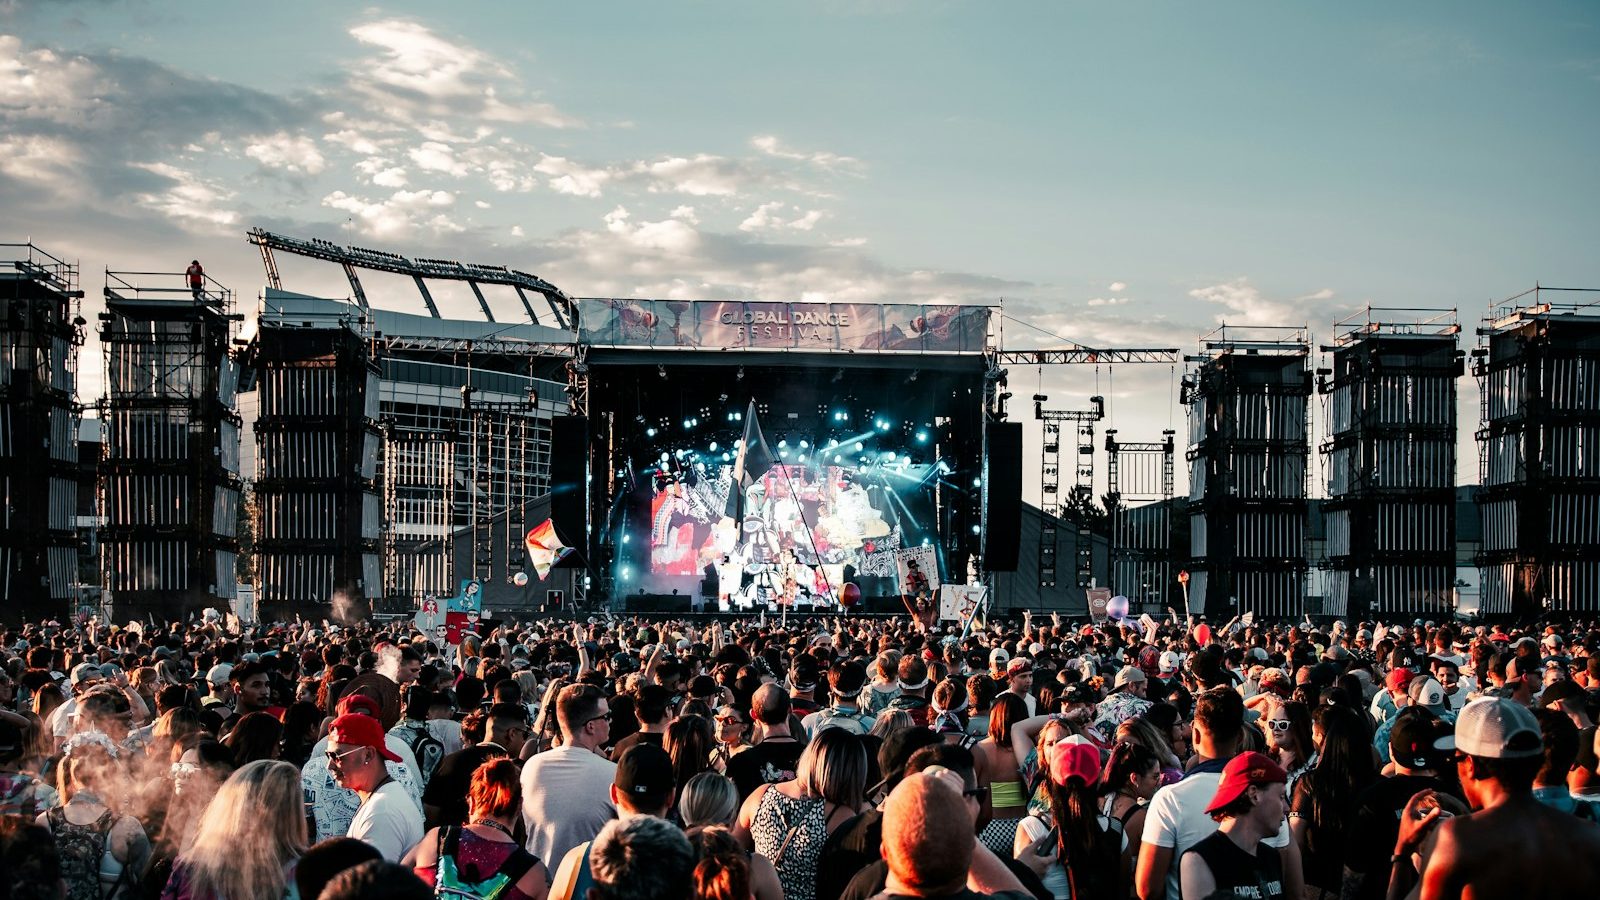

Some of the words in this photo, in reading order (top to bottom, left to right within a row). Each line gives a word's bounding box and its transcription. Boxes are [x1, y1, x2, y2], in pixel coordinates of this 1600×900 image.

[720, 310, 788, 325] GLOBAL
[793, 311, 850, 327] DANCE
[737, 326, 833, 341] FESTIVAL
[1233, 885, 1263, 899] EMPRE
